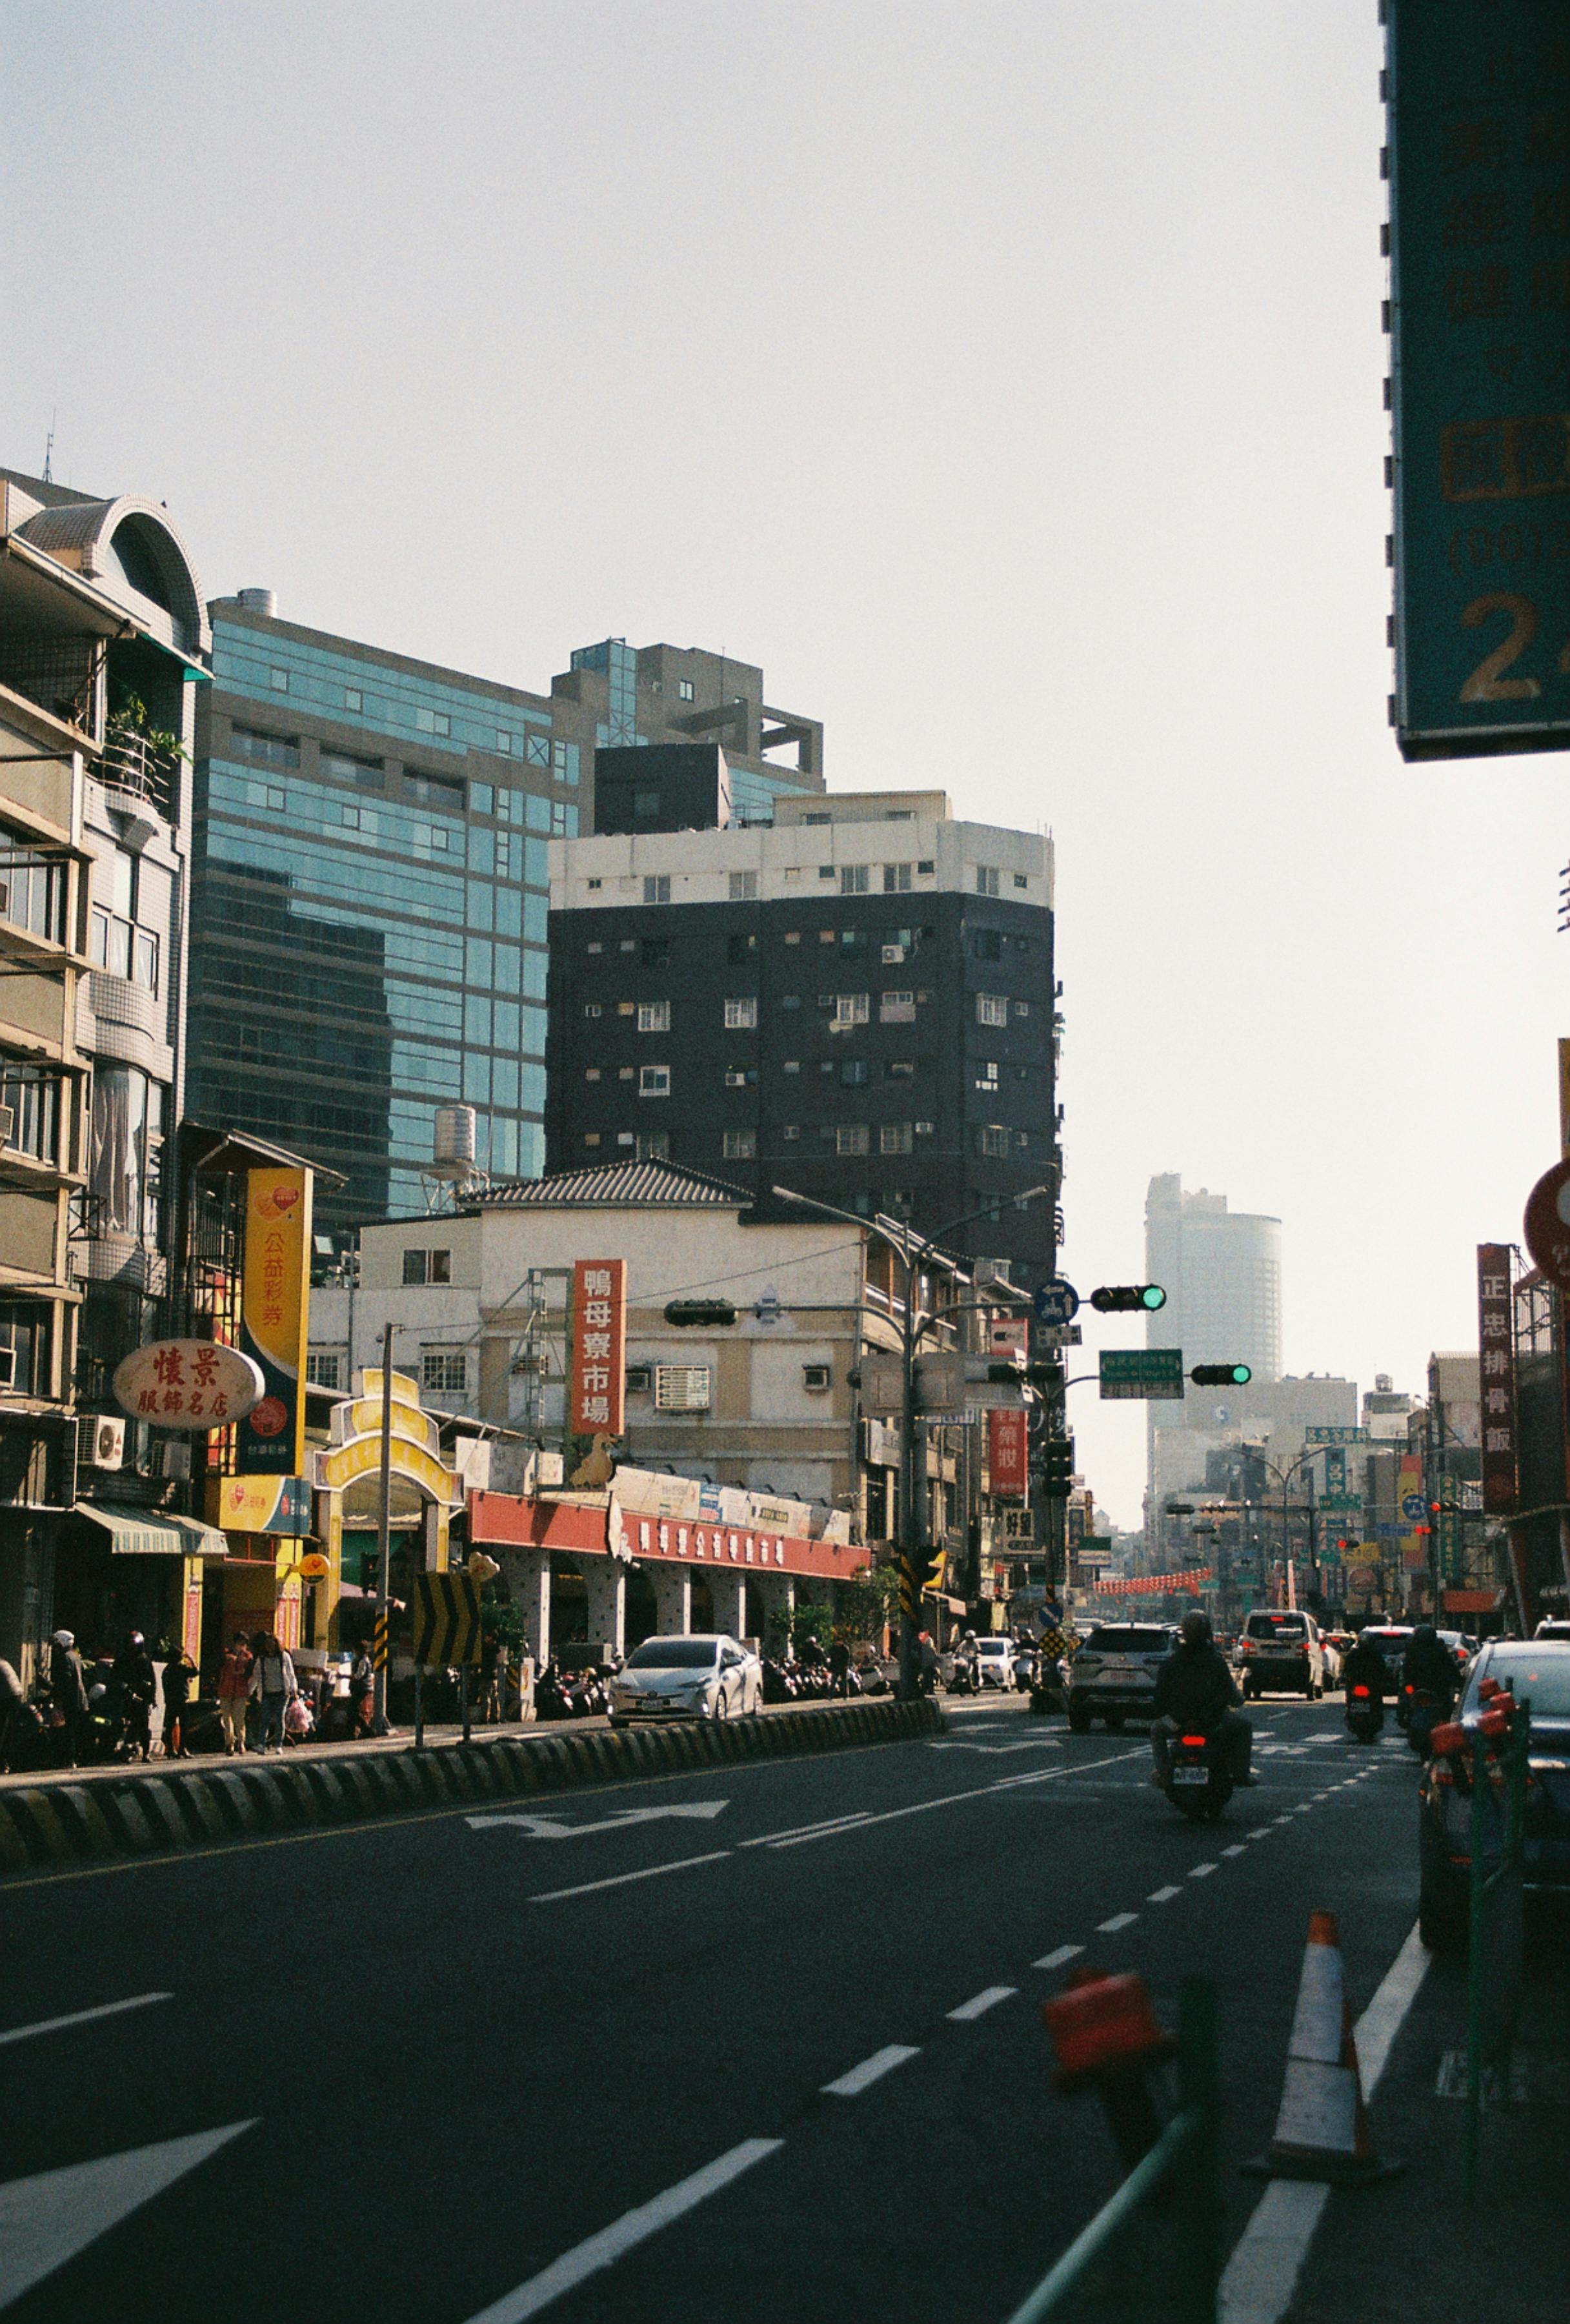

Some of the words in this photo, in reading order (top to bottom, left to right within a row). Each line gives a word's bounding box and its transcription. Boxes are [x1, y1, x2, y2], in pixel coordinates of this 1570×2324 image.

[1459, 592, 1570, 703] 2
[263, 1232, 285, 1326] 公益彩券
[152, 1348, 221, 1388] 懷景
[581, 1269, 612, 1425] 鴨母寮市場
[1482, 1275, 1512, 1453] 正忠排骨飯
[137, 1389, 229, 1417] 服飾名店
